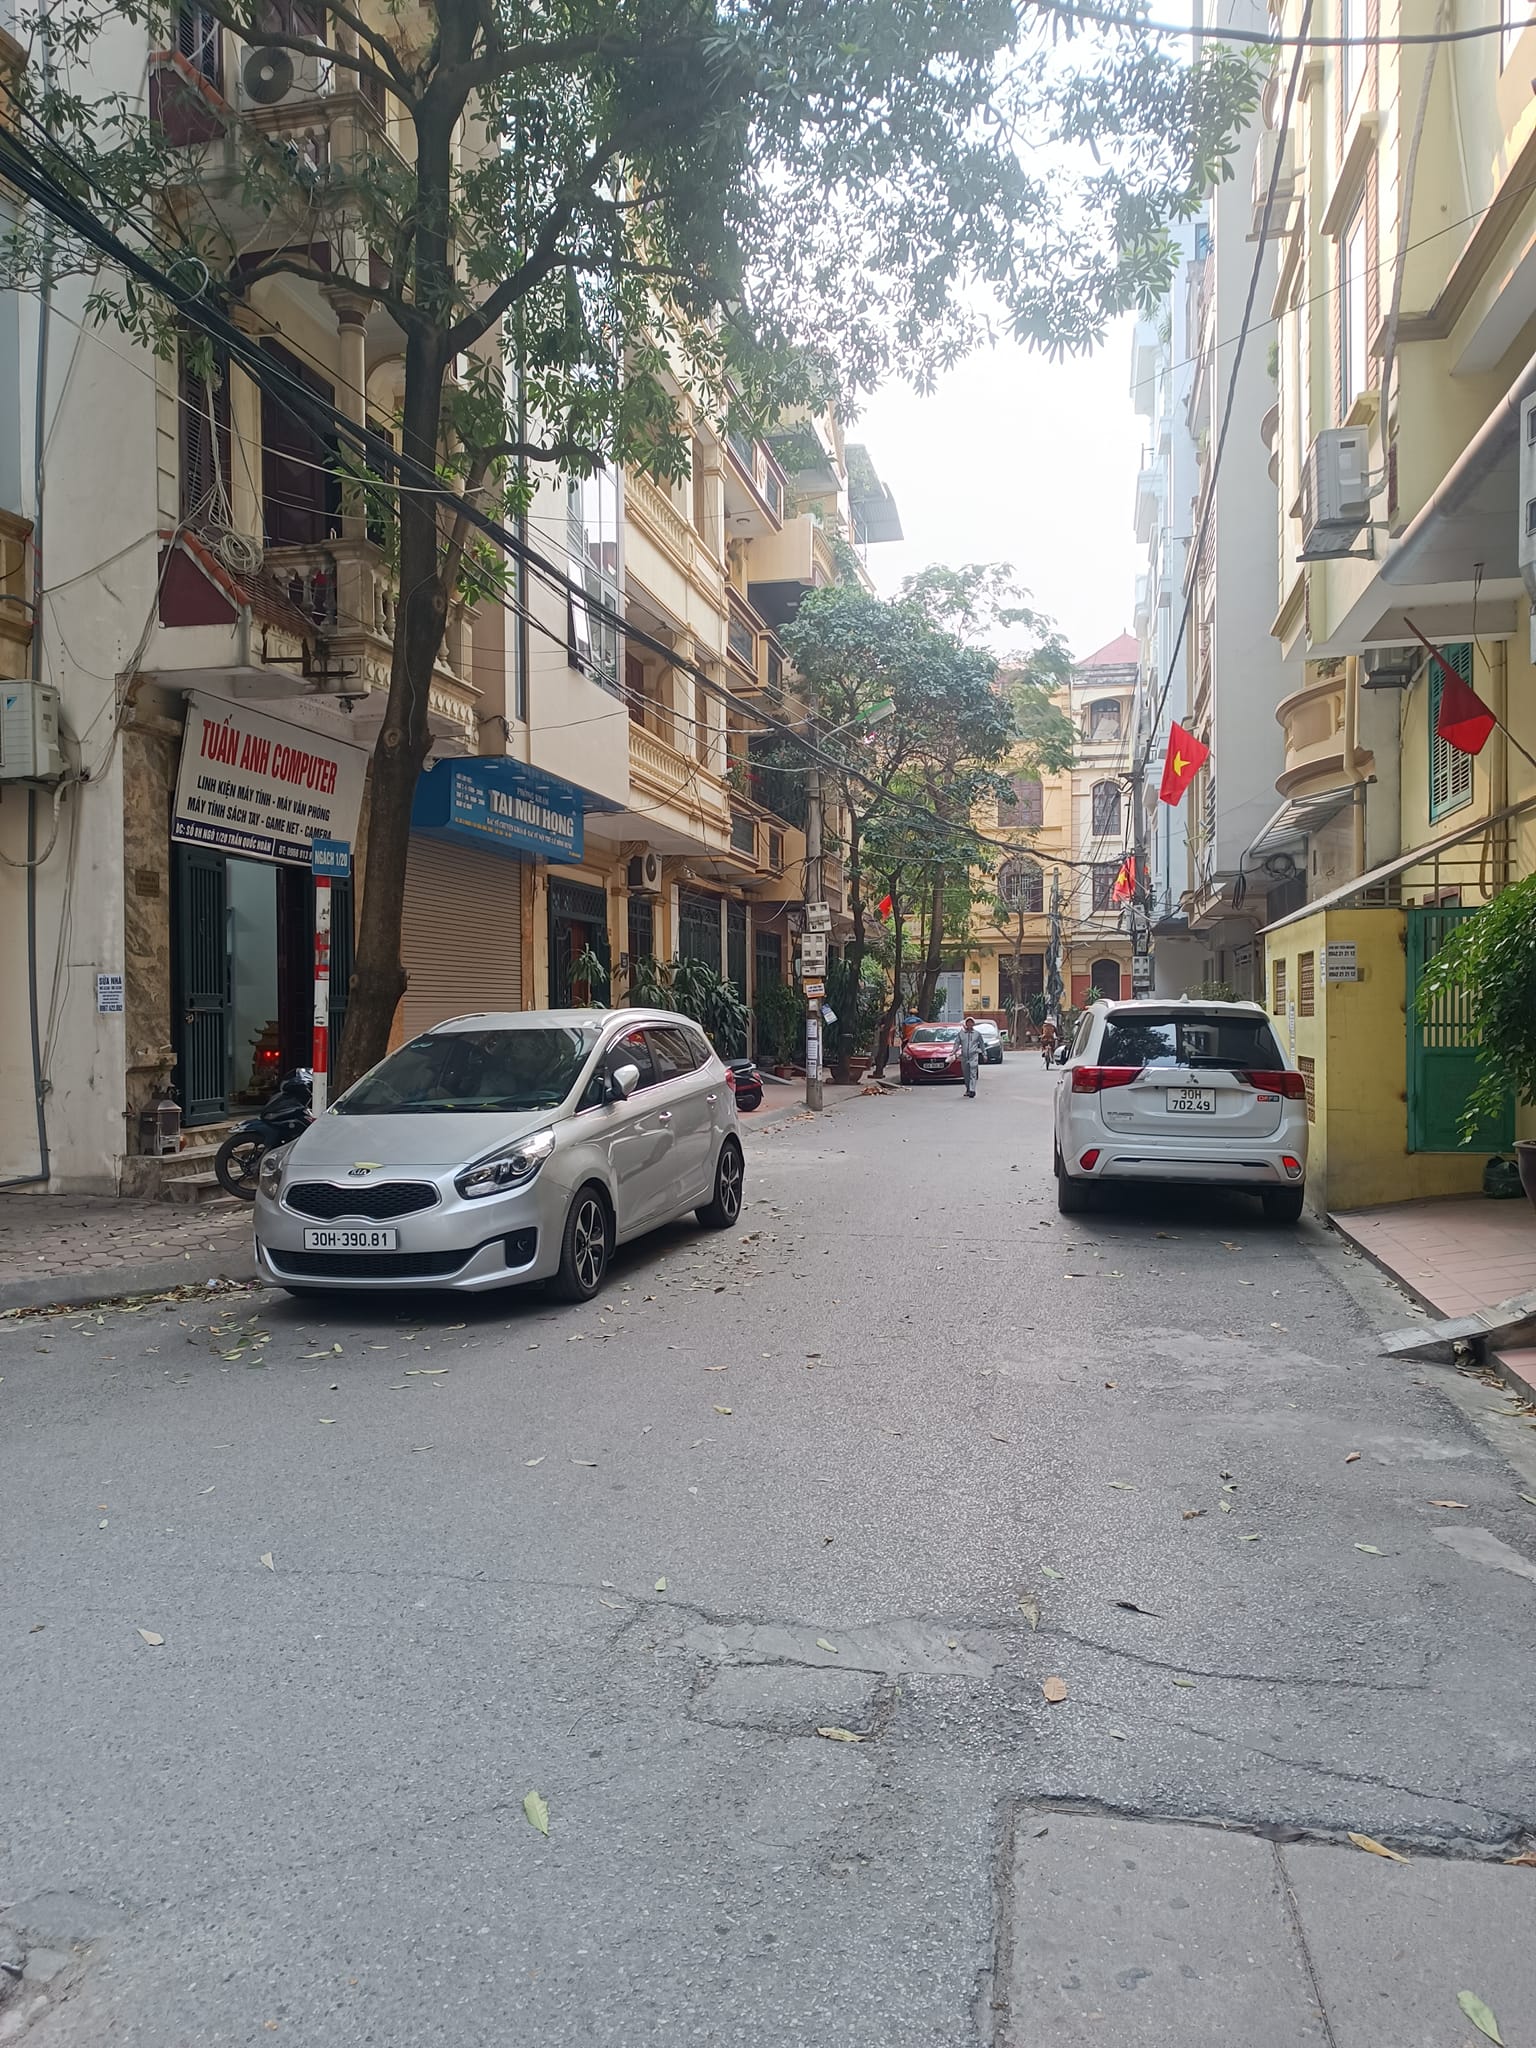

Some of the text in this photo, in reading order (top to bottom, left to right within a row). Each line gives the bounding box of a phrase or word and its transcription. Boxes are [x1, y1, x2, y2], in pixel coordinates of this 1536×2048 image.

[200, 714, 338, 795] TUẤN ANH COMPUTER
[197, 775, 216, 793] LINH
[217, 780, 236, 799] KIỆN
[237, 785, 254, 802] MÁY
[255, 789, 271, 806] TÍNH
[277, 796, 292, 812] MÁY
[293, 800, 306, 816] VĂN
[307, 804, 330, 821] PHÒNG
[187, 796, 206, 814] MÁY
[207, 800, 226, 818] TÍNH
[226, 805, 247, 823] SÁCH
[248, 811, 260, 826] TAY
[265, 816, 285, 832] GAME
[286, 821, 299, 835] NET
[489, 789, 513, 817] TAI
[515, 798, 540, 825] MŨI
[542, 808, 574, 838] HỌNG
[315, 847, 334, 865] NGÁCH
[335, 852, 348, 867] 1/20
[1172, 1100, 1210, 1111] 702.49
[1181, 1089, 1202, 1099] 30H
[312, 1232, 387, 1247] 30H-390.81
